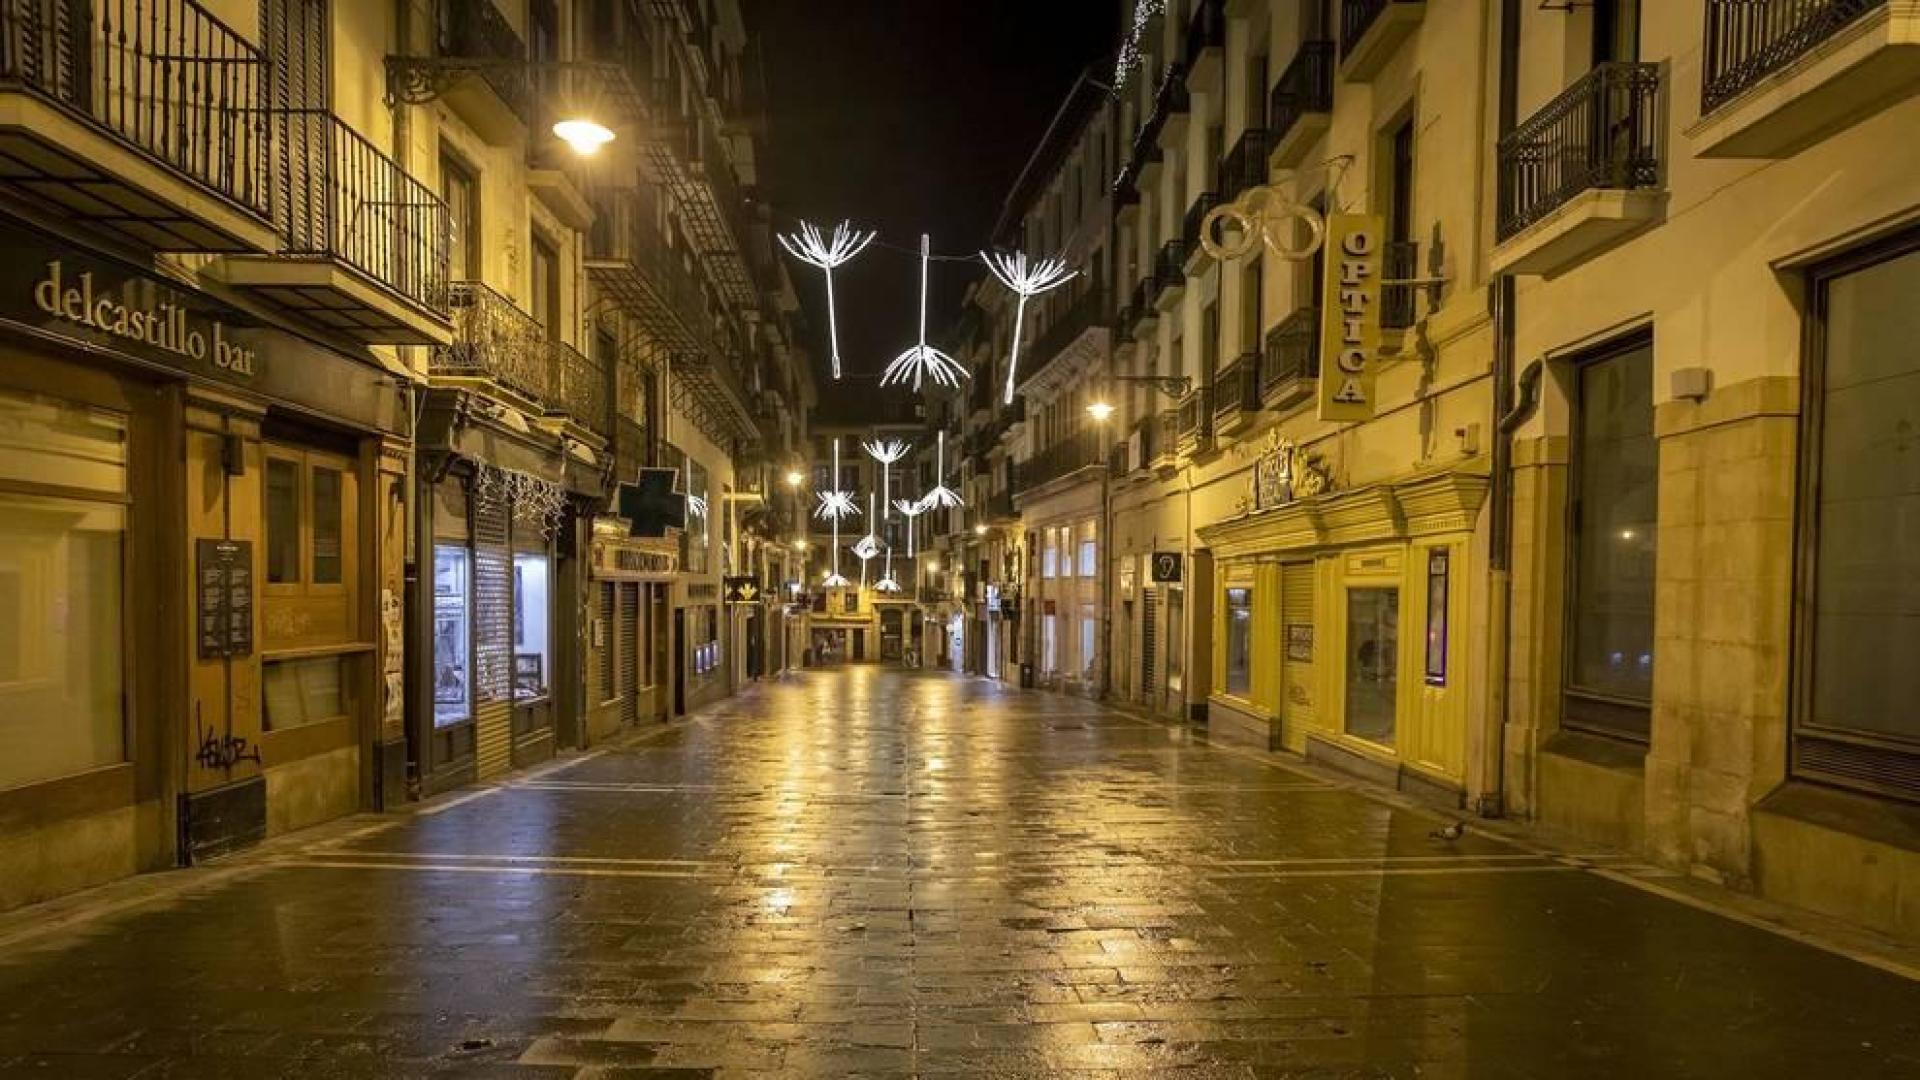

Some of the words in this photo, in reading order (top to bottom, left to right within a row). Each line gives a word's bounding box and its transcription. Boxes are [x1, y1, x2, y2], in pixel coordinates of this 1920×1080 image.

[34, 260, 206, 360] delcastillo
[213, 321, 255, 376] bar
[1332, 231, 1374, 403] OPTICA
